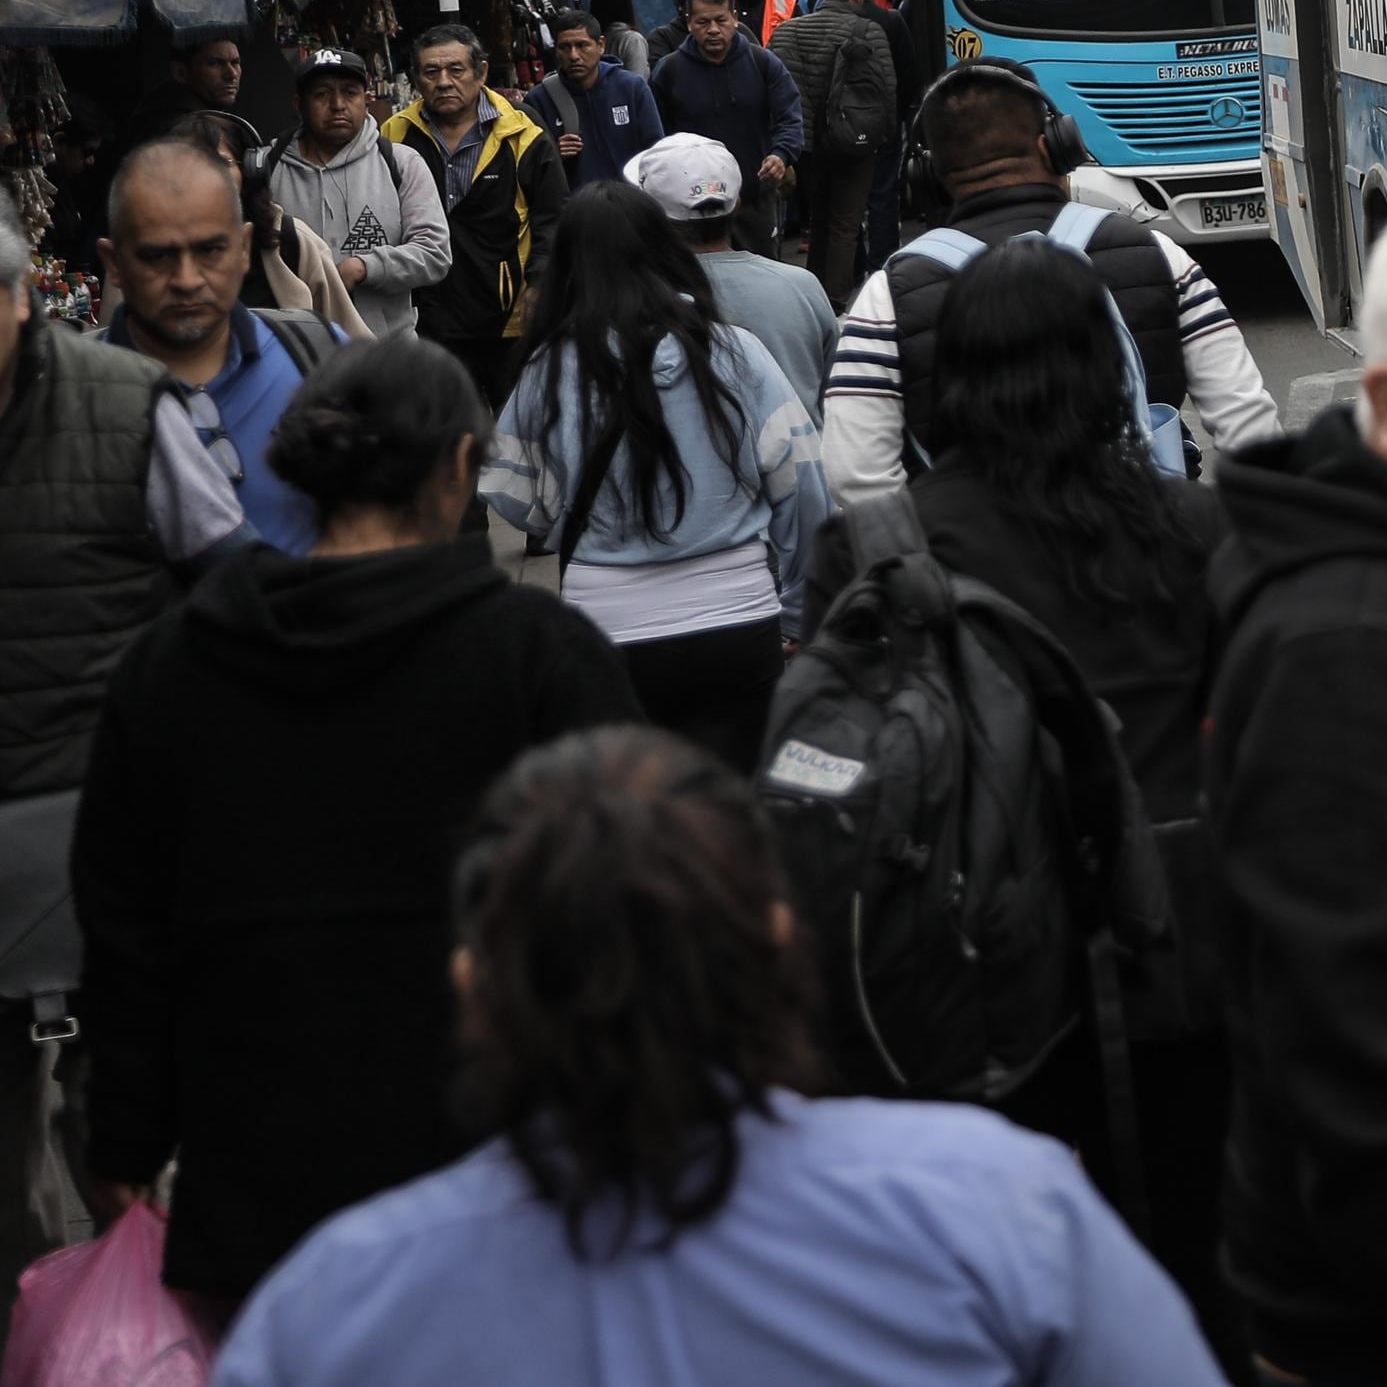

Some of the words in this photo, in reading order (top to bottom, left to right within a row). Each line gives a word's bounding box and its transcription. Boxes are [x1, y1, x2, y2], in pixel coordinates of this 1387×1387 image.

[958, 37, 976, 60] 07
[1158, 67, 1175, 79] E.T.
[1178, 63, 1223, 79] PEGASSO
[1204, 202, 1266, 224] B3U-786
